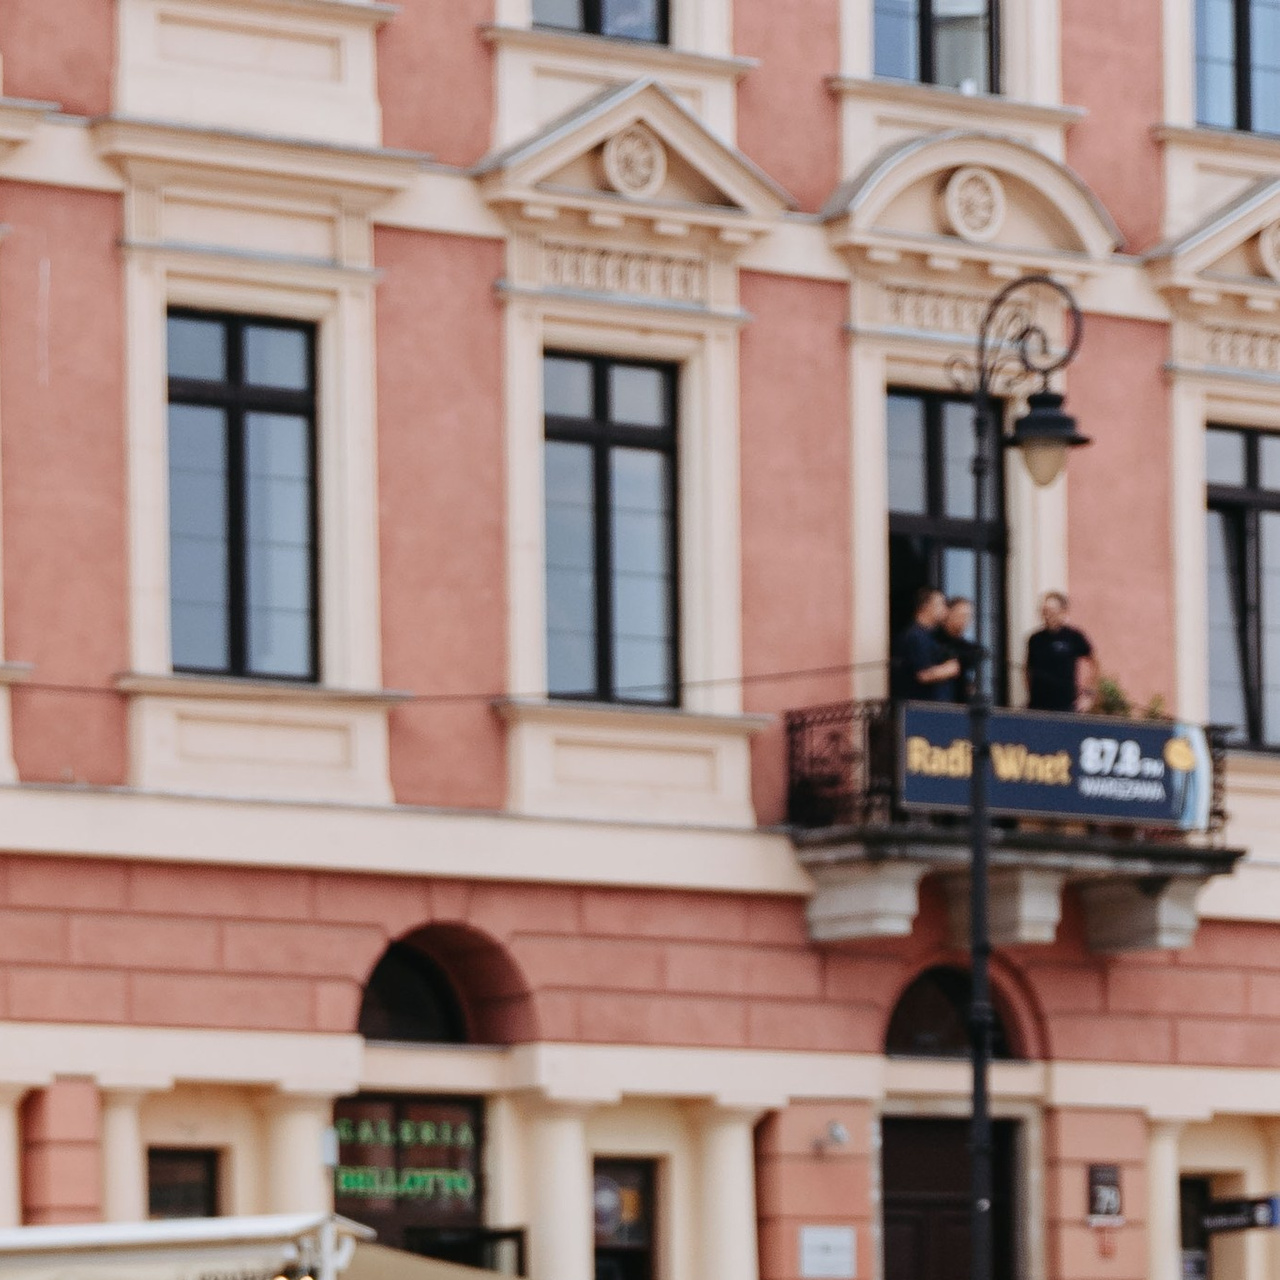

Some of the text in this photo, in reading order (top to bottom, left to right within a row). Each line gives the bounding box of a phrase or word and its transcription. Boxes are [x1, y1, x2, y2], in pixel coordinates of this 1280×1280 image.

[906, 736, 1071, 786] Radi Wnet
[1080, 736, 1141, 778] 87.8
[1079, 776, 1167, 802] WARSZAWA
